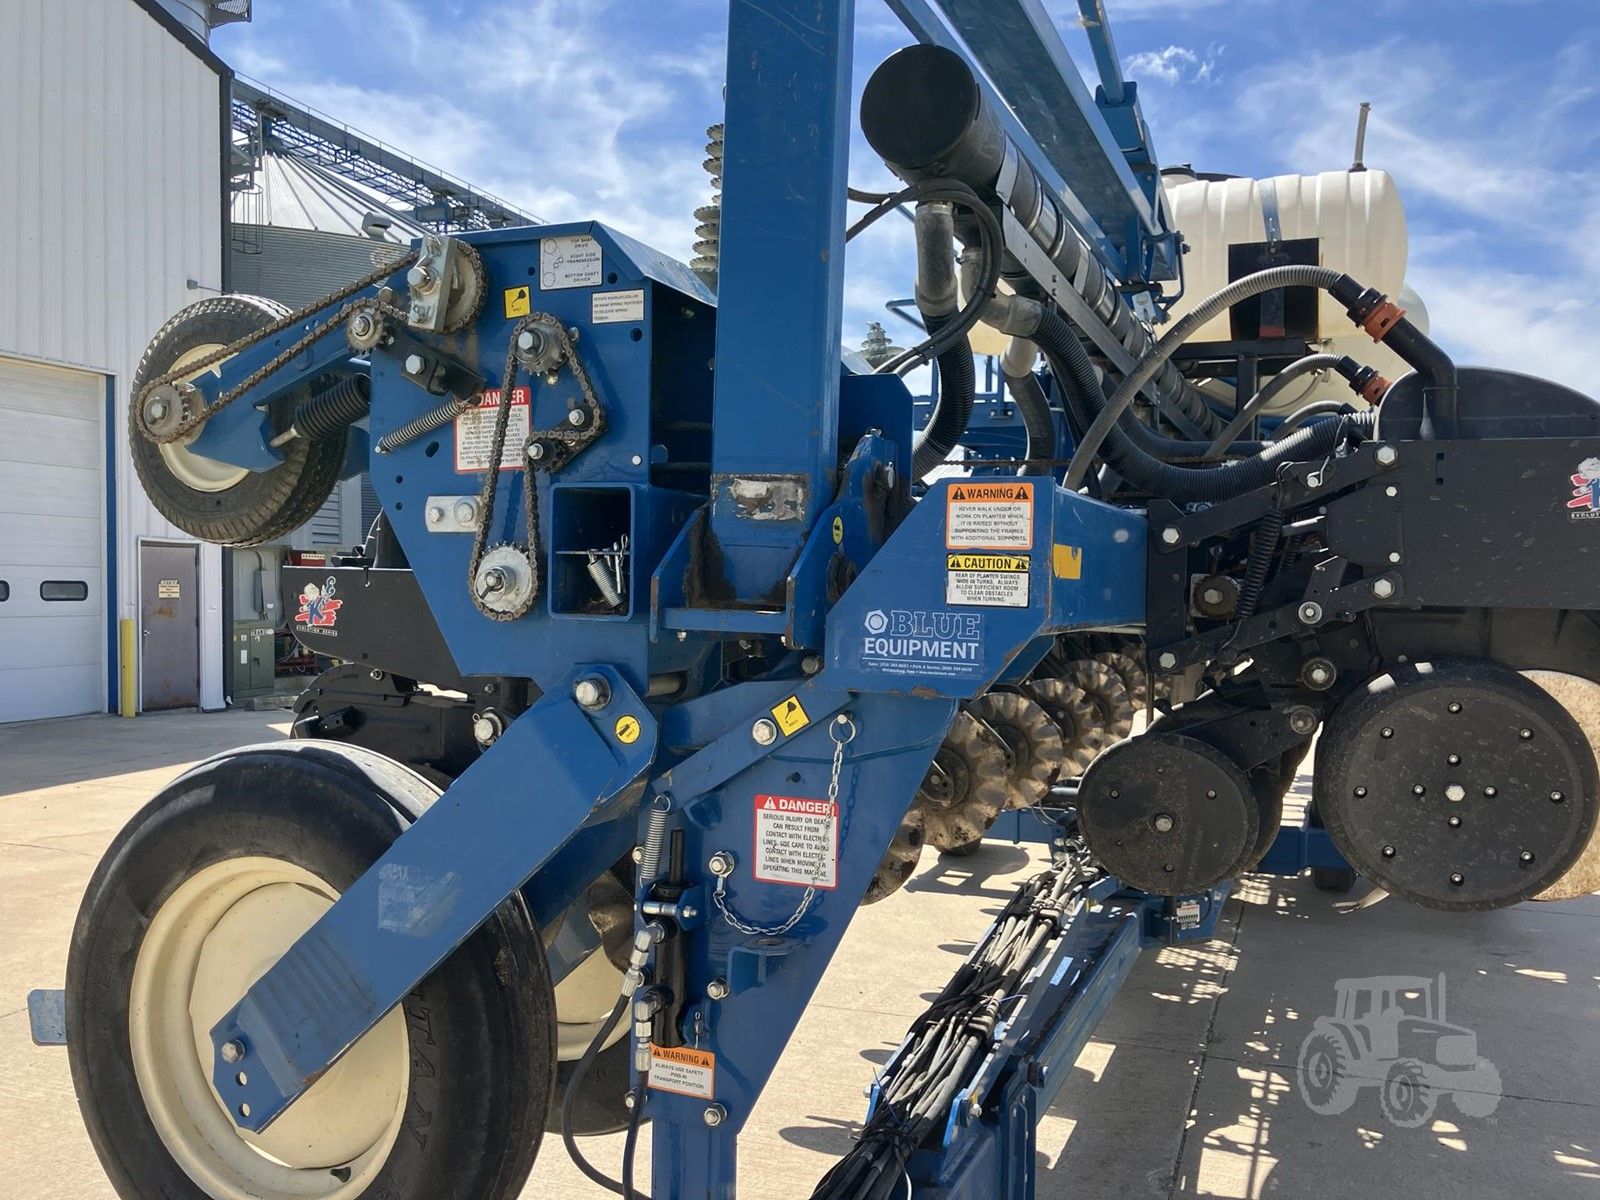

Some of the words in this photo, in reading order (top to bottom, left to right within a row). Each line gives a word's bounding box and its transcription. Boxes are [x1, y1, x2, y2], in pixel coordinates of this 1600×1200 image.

[479, 389, 525, 406] ANER
[967, 489, 1014, 499] WARNING
[964, 557, 1012, 569] CAUTION
[890, 610, 981, 640] BLUE
[864, 637, 979, 660] EQUIPMENT
[779, 798, 831, 814] DANGER
[763, 813, 785, 821] SERIOUS
[766, 830, 788, 839] CONTACT
[766, 847, 788, 855] CONTACT
[788, 849, 802, 857] WITH
[765, 856, 779, 864] LINES
[763, 864, 790, 873] OPERATING
[791, 867, 802, 875] THIS
[663, 1050, 699, 1064] WARNING
[655, 1062, 675, 1071] ALWAYS
[685, 1068, 704, 1076] SAFETY
[654, 1074, 681, 1084] TRANSPORT
[682, 1080, 704, 1089] POSITION
